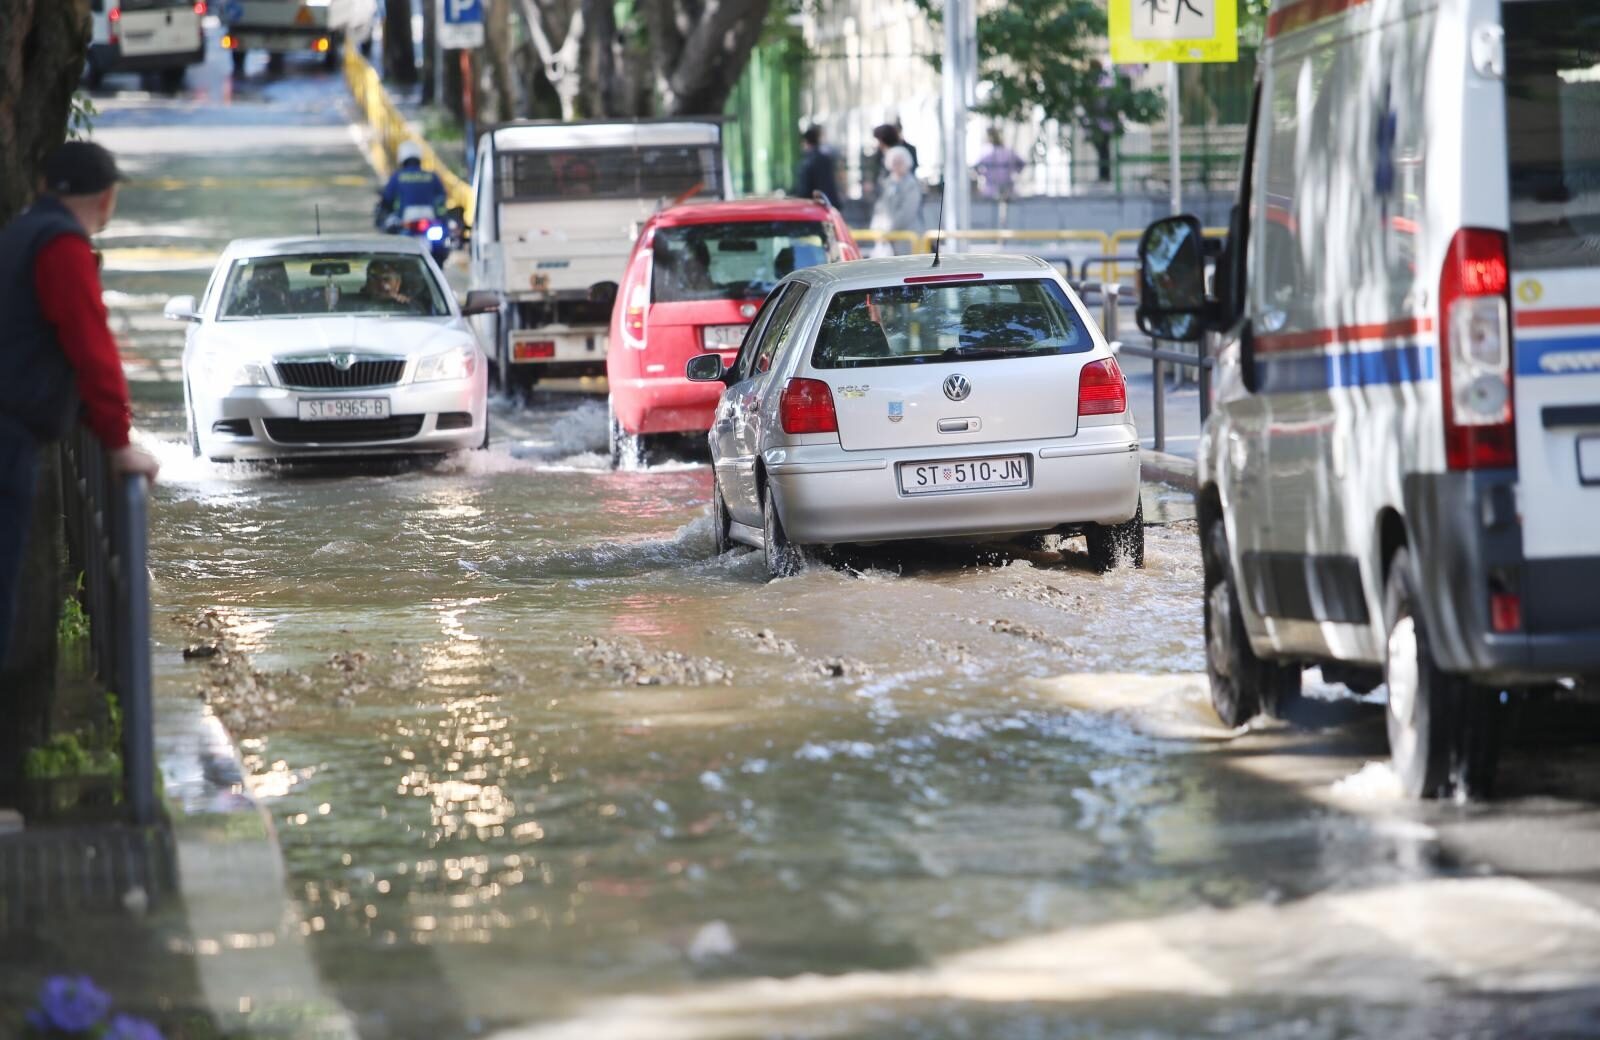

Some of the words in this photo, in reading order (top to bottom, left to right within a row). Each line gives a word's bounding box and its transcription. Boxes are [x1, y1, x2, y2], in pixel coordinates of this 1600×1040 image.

[310, 400, 326, 417] ST
[335, 399, 383, 417] 9965-B
[916, 465, 939, 486] ST
[954, 460, 1023, 483] 510-JN
